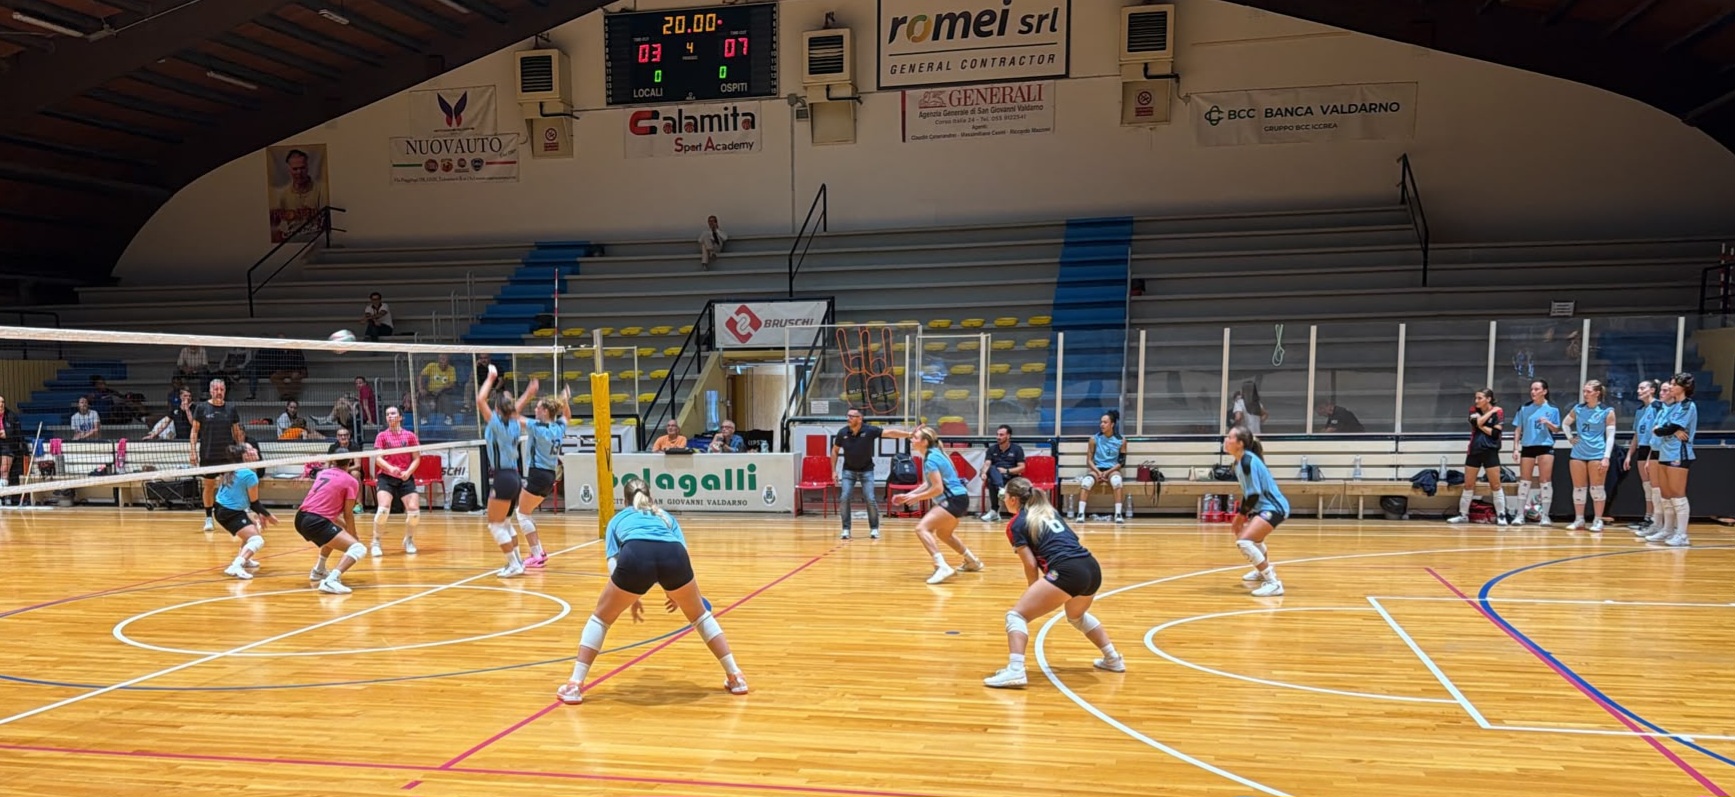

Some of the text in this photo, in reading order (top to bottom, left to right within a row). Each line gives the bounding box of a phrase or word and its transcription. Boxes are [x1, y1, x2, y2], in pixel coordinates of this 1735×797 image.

[888, 0, 1058, 44] romei srl
[638, 43, 662, 63] 03
[686, 42, 694, 53] 4
[724, 37, 748, 58] 07
[719, 66, 727, 78] 0
[890, 54, 1056, 75] GENERAL CONTRACTOR
[654, 70, 662, 82] 0
[633, 88, 663, 98] LOCALI
[721, 82, 747, 92] OSPITI
[949, 84, 1044, 107] GENERALI
[918, 110, 942, 119] Agenzia
[943, 108, 969, 116] Generale
[990, 104, 1015, 114] Giovanni
[1018, 103, 1043, 112] Valdarno
[1227, 102, 1400, 120] BCC BANCA VALDARNO
[629, 106, 756, 135] Calamita
[406, 137, 502, 155] NUOVAUTO
[675, 136, 754, 154] Sport Academy
[763, 318, 814, 328] BRUSCHI
[1582, 423, 1590, 432] 21
[313, 478, 330, 493] 7
